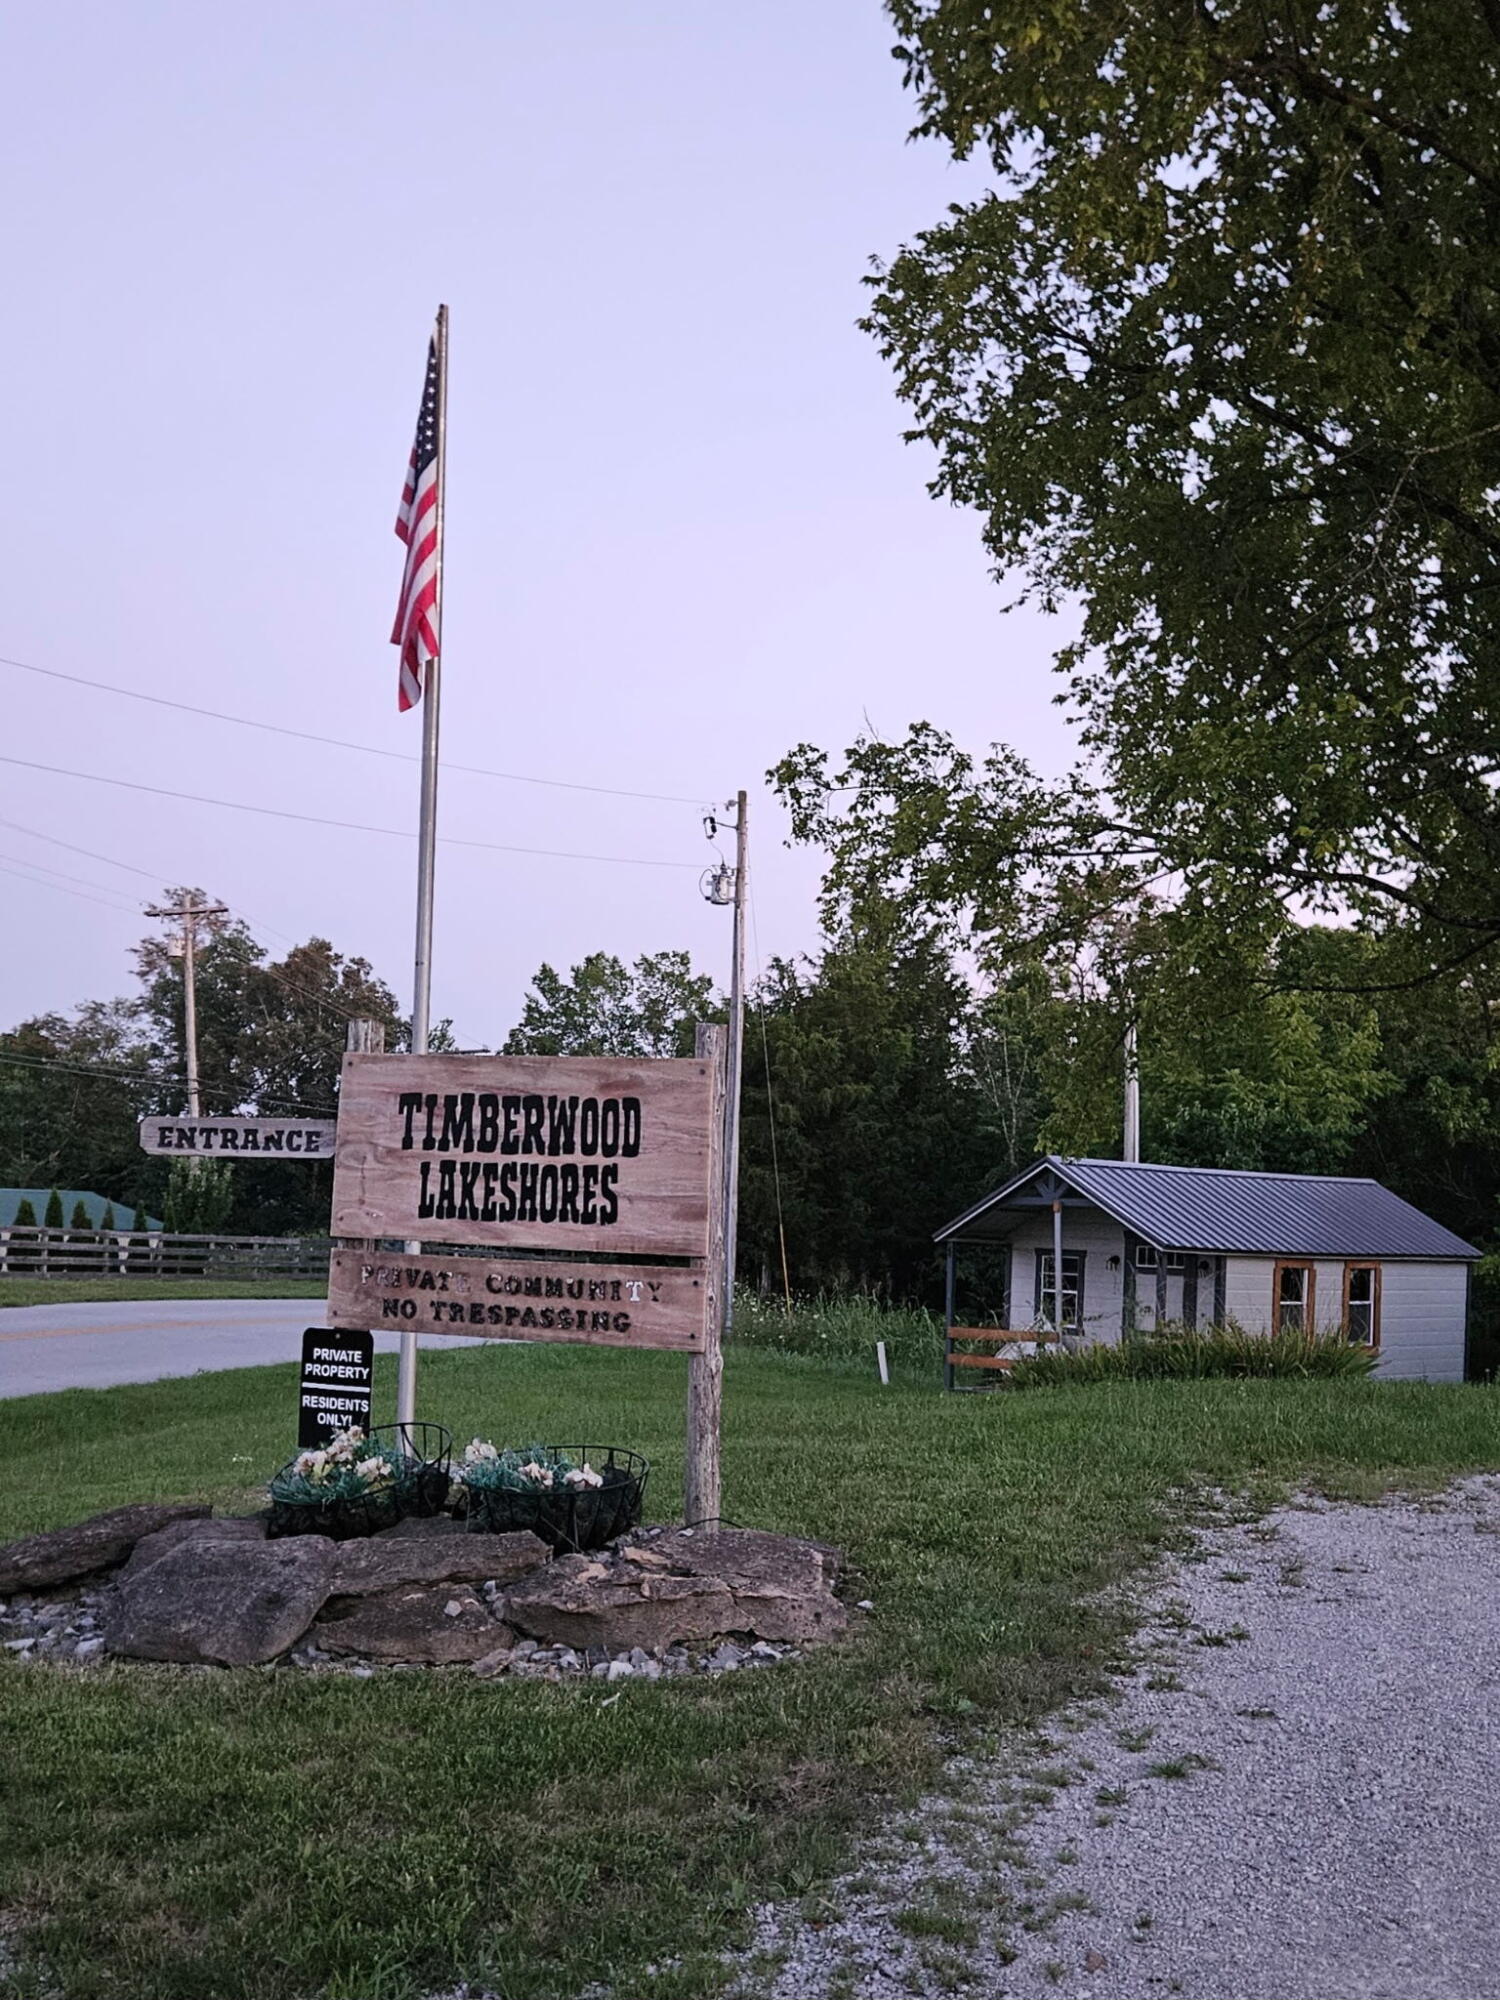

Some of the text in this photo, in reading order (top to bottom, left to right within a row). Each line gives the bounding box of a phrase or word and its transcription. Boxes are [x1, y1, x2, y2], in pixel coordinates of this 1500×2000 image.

[398, 1092, 642, 1157] TIMBERWOOD
[157, 1127, 322, 1152] ENTRANCE
[418, 1160, 619, 1225] LAKESHORES
[361, 1264, 663, 1303] PRIVATE COMMUNITY
[382, 1298, 631, 1333] NO TRESPASSING
[313, 1347, 363, 1363] PRIVATE
[304, 1363, 370, 1380] PROPERTY
[302, 1395, 369, 1413] RESIDENTS
[317, 1412, 353, 1427] ONLY!
